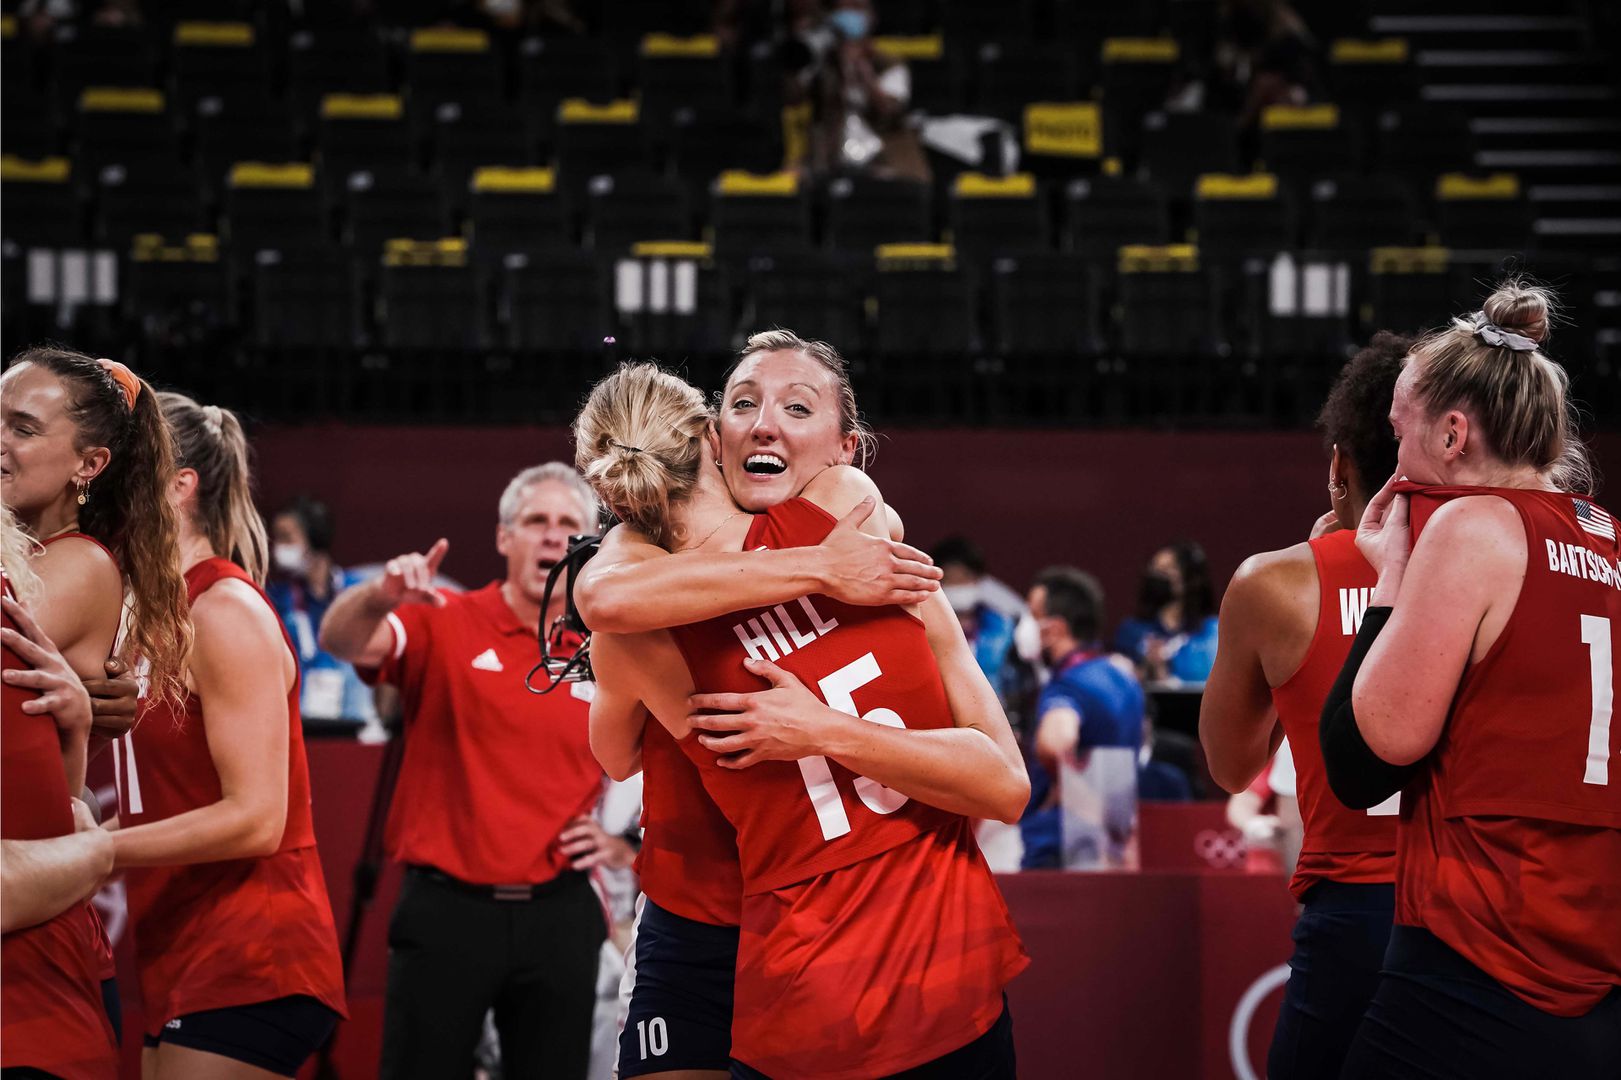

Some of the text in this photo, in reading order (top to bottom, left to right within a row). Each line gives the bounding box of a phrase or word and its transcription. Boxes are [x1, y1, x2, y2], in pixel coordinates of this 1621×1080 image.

[733, 595, 839, 662] HILL
[1339, 587, 1376, 636] W
[637, 1016, 669, 1060] 10
